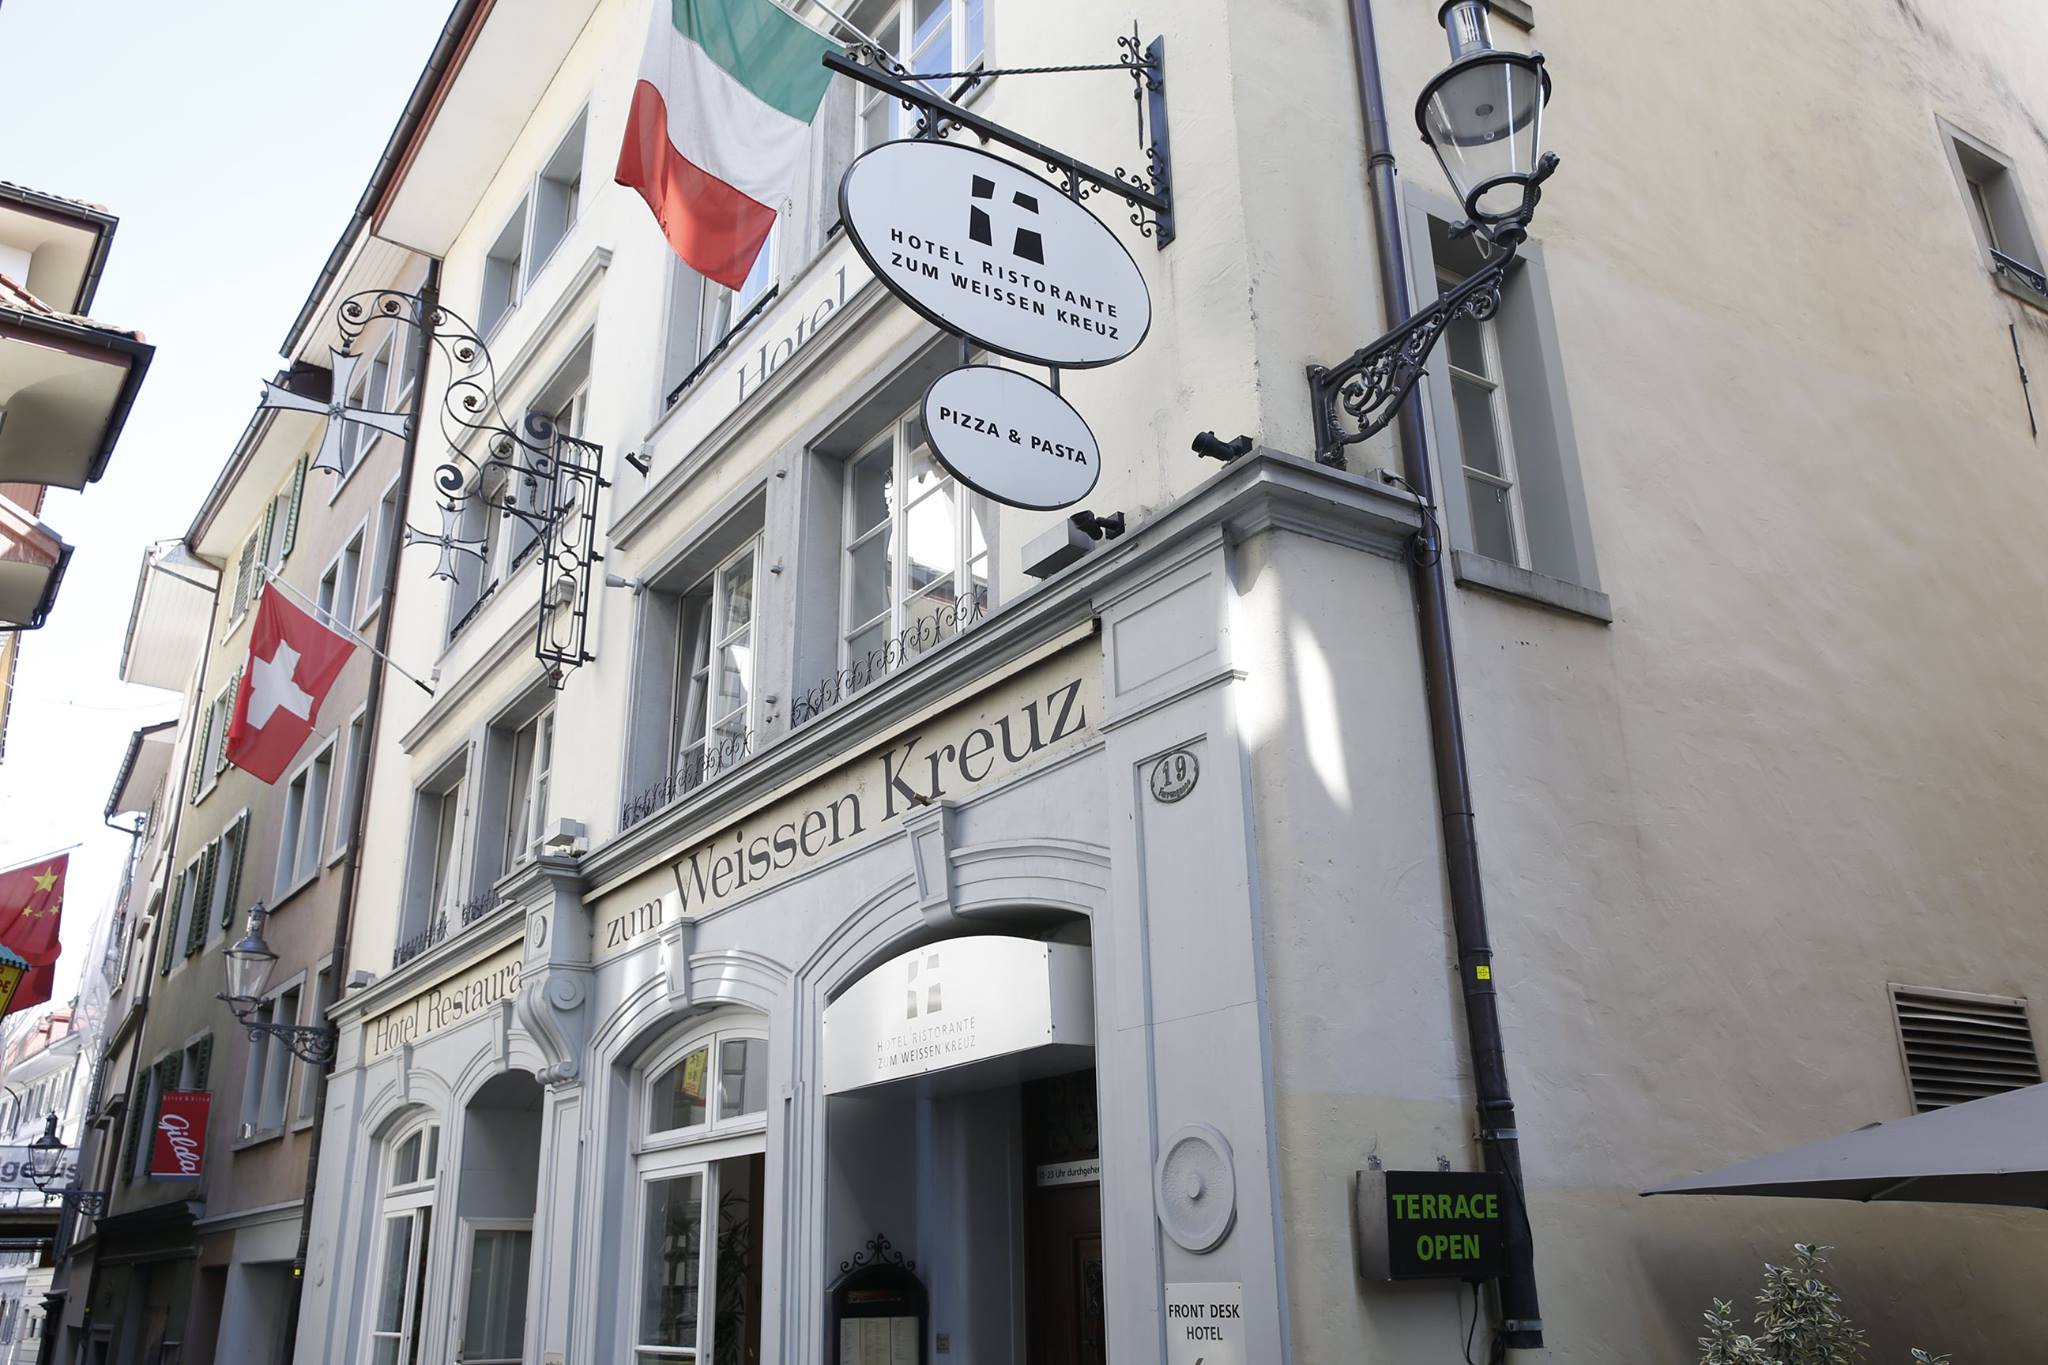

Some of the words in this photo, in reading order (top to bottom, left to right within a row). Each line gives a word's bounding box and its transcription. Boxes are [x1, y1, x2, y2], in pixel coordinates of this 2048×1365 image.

[891, 228, 964, 265] HOTEL
[982, 261, 1118, 318] RISTORANTE
[891, 251, 940, 280] ZUM
[951, 272, 1046, 316] WEISSEN
[1057, 309, 1120, 340] KREUZ
[737, 264, 846, 401] Hotel
[939, 406, 1000, 438] PIZZA
[1008, 429, 1021, 444] &
[1031, 436, 1088, 465] PASTA
[1162, 755, 1187, 787] 19
[606, 896, 663, 951] zum
[671, 791, 866, 912] Weissen
[879, 677, 1087, 823] Kreuz
[374, 1000, 420, 1056] Hotel
[877, 1035, 908, 1053] HOTEL
[912, 1016, 976, 1044] RISTORANTE
[877, 1054, 898, 1069] ZUM
[901, 1044, 941, 1064] WEISSEN
[944, 1035, 976, 1054] KREUZ
[158, 1113, 200, 1176] Gilda
[1055, 1167, 1066, 1178] Uhr
[1391, 1193, 1499, 1220] TERRACE
[1416, 1235, 1481, 1261] OPEN
[1168, 1304, 1205, 1318] FRONT
[1209, 1304, 1241, 1318] DESK
[1186, 1326, 1224, 1341] HOTEL
